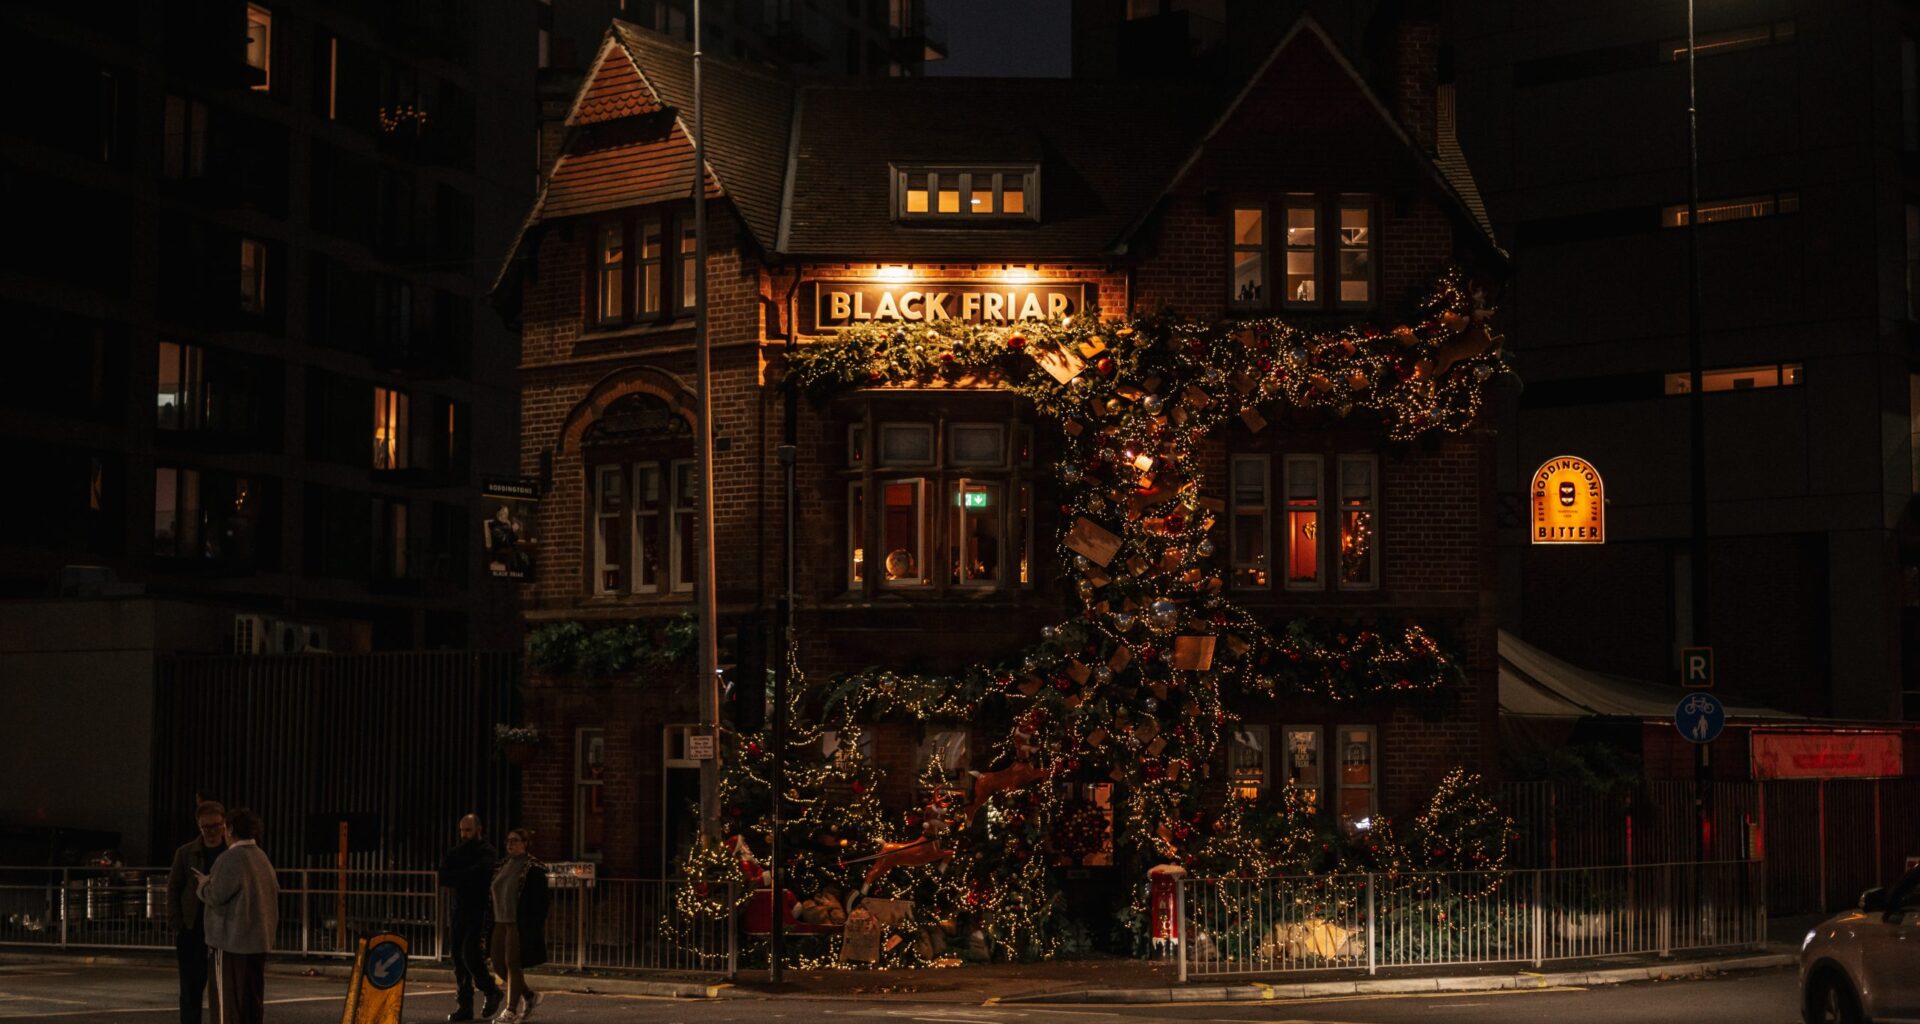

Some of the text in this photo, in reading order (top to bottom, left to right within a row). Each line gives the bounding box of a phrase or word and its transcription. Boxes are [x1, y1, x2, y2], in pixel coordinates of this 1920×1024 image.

[830, 291, 1069, 320] BLACK FRIAR
[1537, 460, 1599, 498] BODDINGTONS
[1539, 527, 1598, 538] BITTER
[1689, 656, 1708, 681] R
